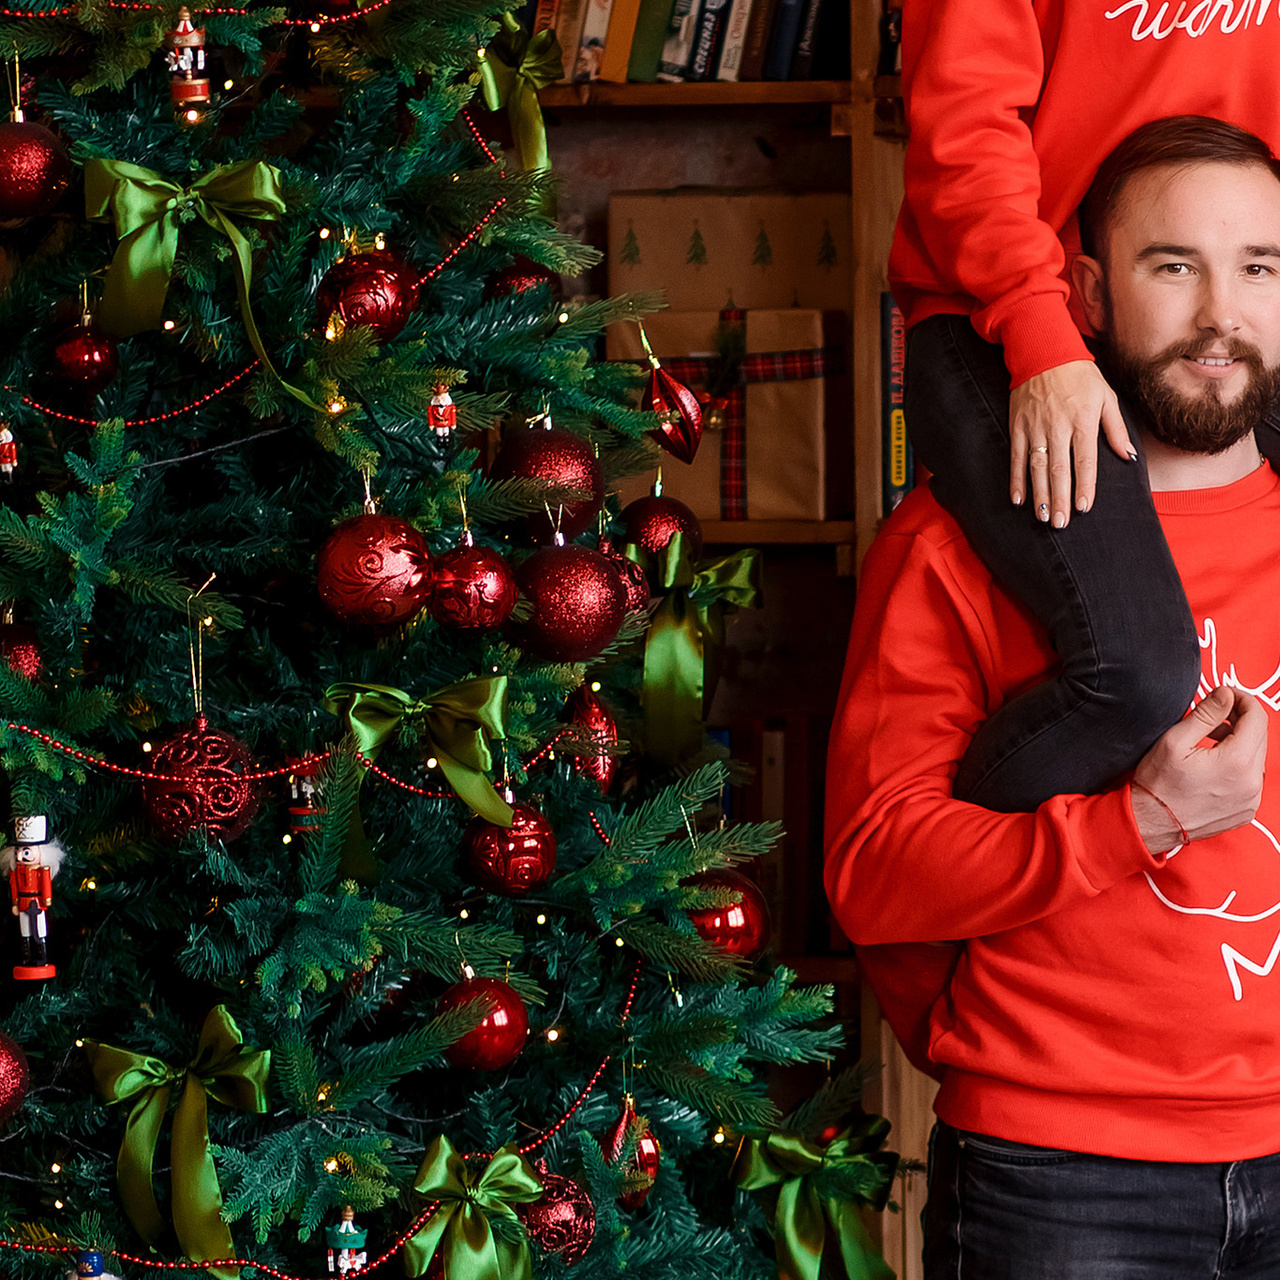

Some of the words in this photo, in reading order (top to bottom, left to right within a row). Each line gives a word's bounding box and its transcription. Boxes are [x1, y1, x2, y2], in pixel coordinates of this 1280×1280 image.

[694, 12, 716, 73] СПЕЦНАЗ
[890, 306, 904, 385] ДАШКОВА
[892, 388, 904, 404] П.
